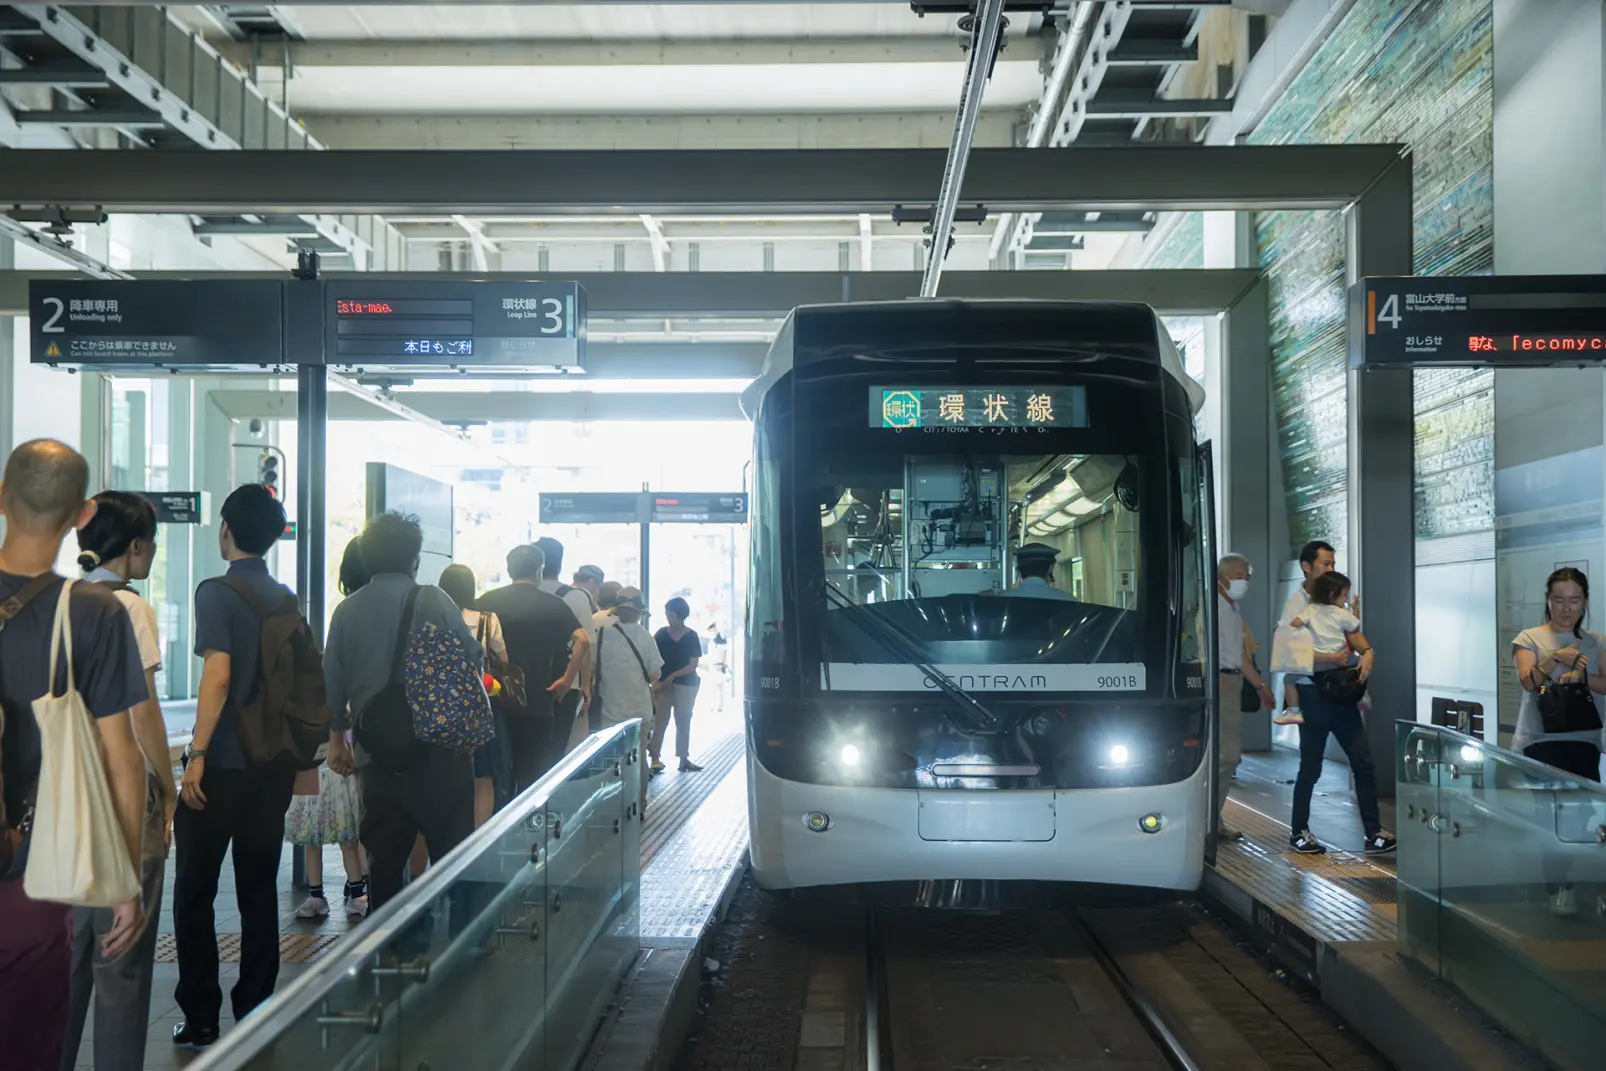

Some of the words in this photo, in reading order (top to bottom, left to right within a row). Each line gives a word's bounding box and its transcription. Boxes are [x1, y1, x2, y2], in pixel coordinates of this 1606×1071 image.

[70, 299, 118, 312] 降車専用
[502, 298, 537, 310] 環状線
[42, 297, 65, 333] 2
[70, 313, 106, 322] Unloading
[106, 313, 122, 322] only
[507, 311, 523, 319] Loop
[541, 298, 562, 333] 3
[1377, 294, 1402, 329] 4
[70, 341, 176, 350] ここからは乗車できません
[1405, 336, 1443, 346] おしらせ
[939, 394, 1054, 423] 環状線
[189, 496, 196, 512] 1
[544, 499, 552, 512] 2
[734, 498, 744, 512] 3
[1097, 675, 1137, 688] 9001B
